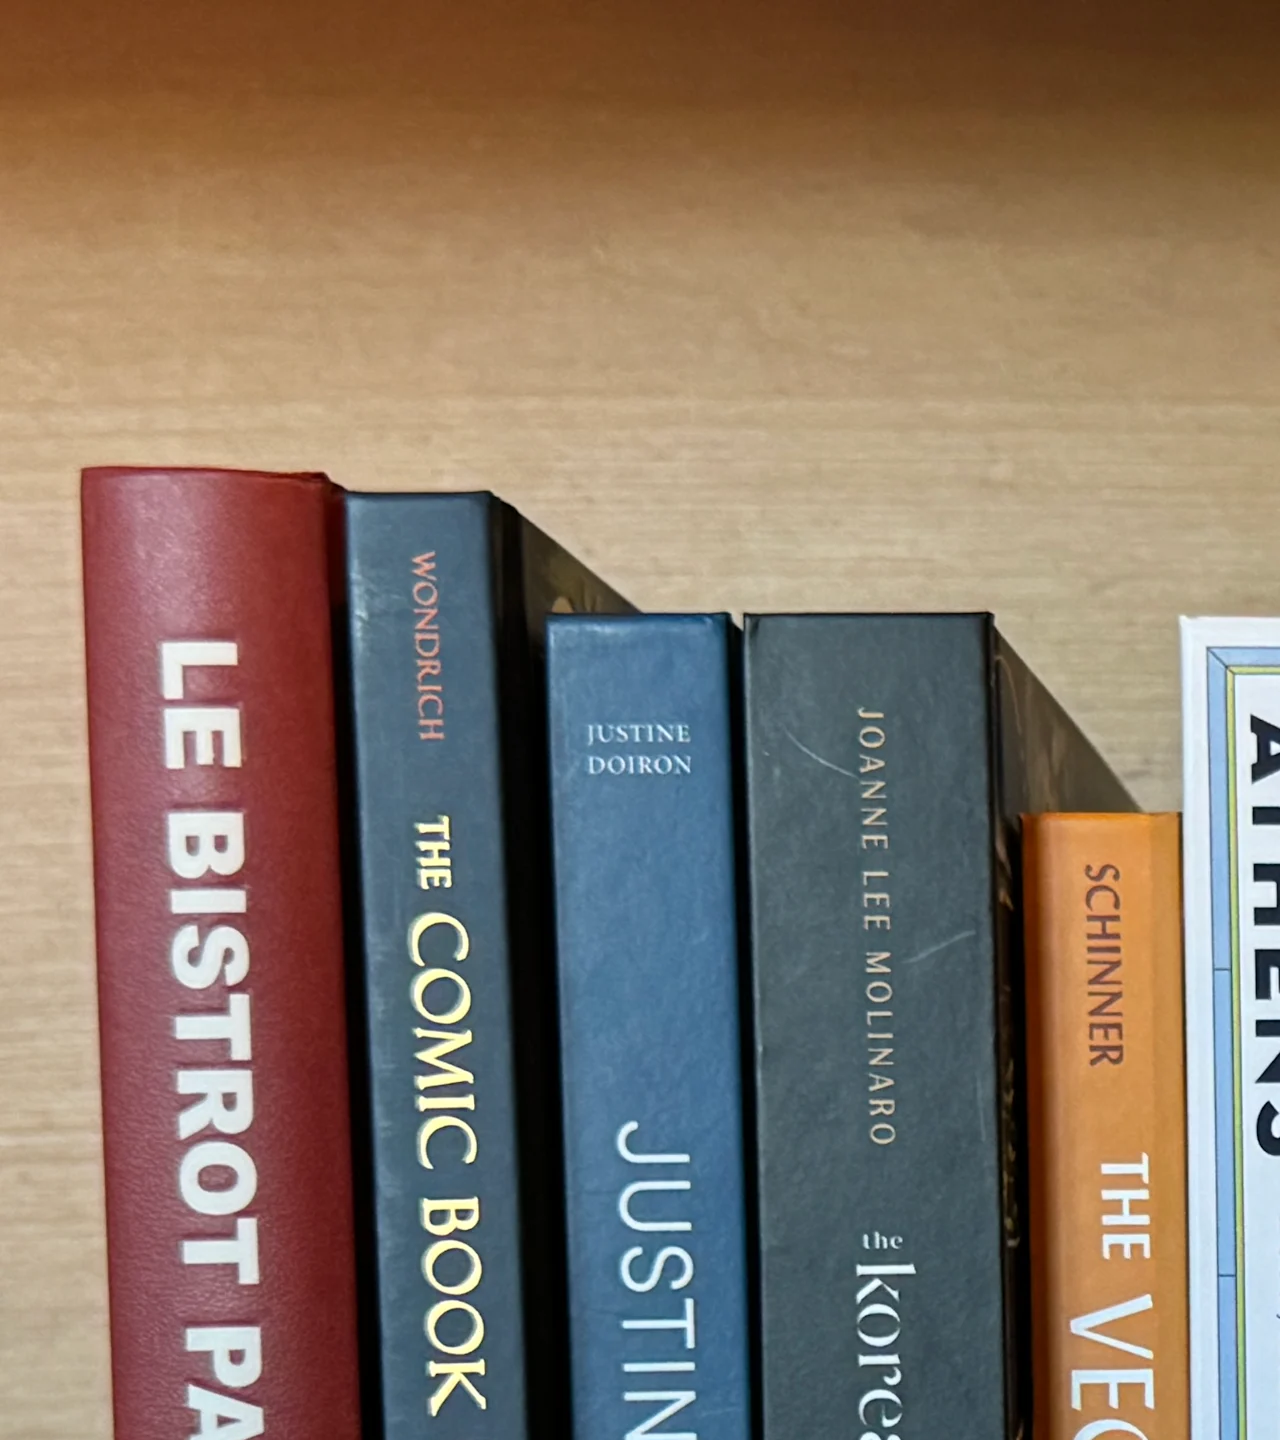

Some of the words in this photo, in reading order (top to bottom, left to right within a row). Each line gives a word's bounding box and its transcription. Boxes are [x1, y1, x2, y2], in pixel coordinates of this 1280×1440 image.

[159, 641, 243, 770] LE
[411, 551, 445, 741] WONDRICH
[586, 723, 691, 744] JUSTINE
[587, 754, 693, 776] DOIRON
[857, 707, 889, 851] JOANNE
[414, 815, 452, 890] THE
[862, 871, 891, 931] LEE
[1084, 864, 1124, 1066] SCHINNER
[164, 812, 260, 1284] BISTROT
[408, 912, 479, 1170] COMIC
[866, 951, 897, 1146] MOLINARO
[862, 1231, 903, 1250] the
[1100, 1152, 1150, 1261] THE
[419, 1196, 487, 1417] BOOK
